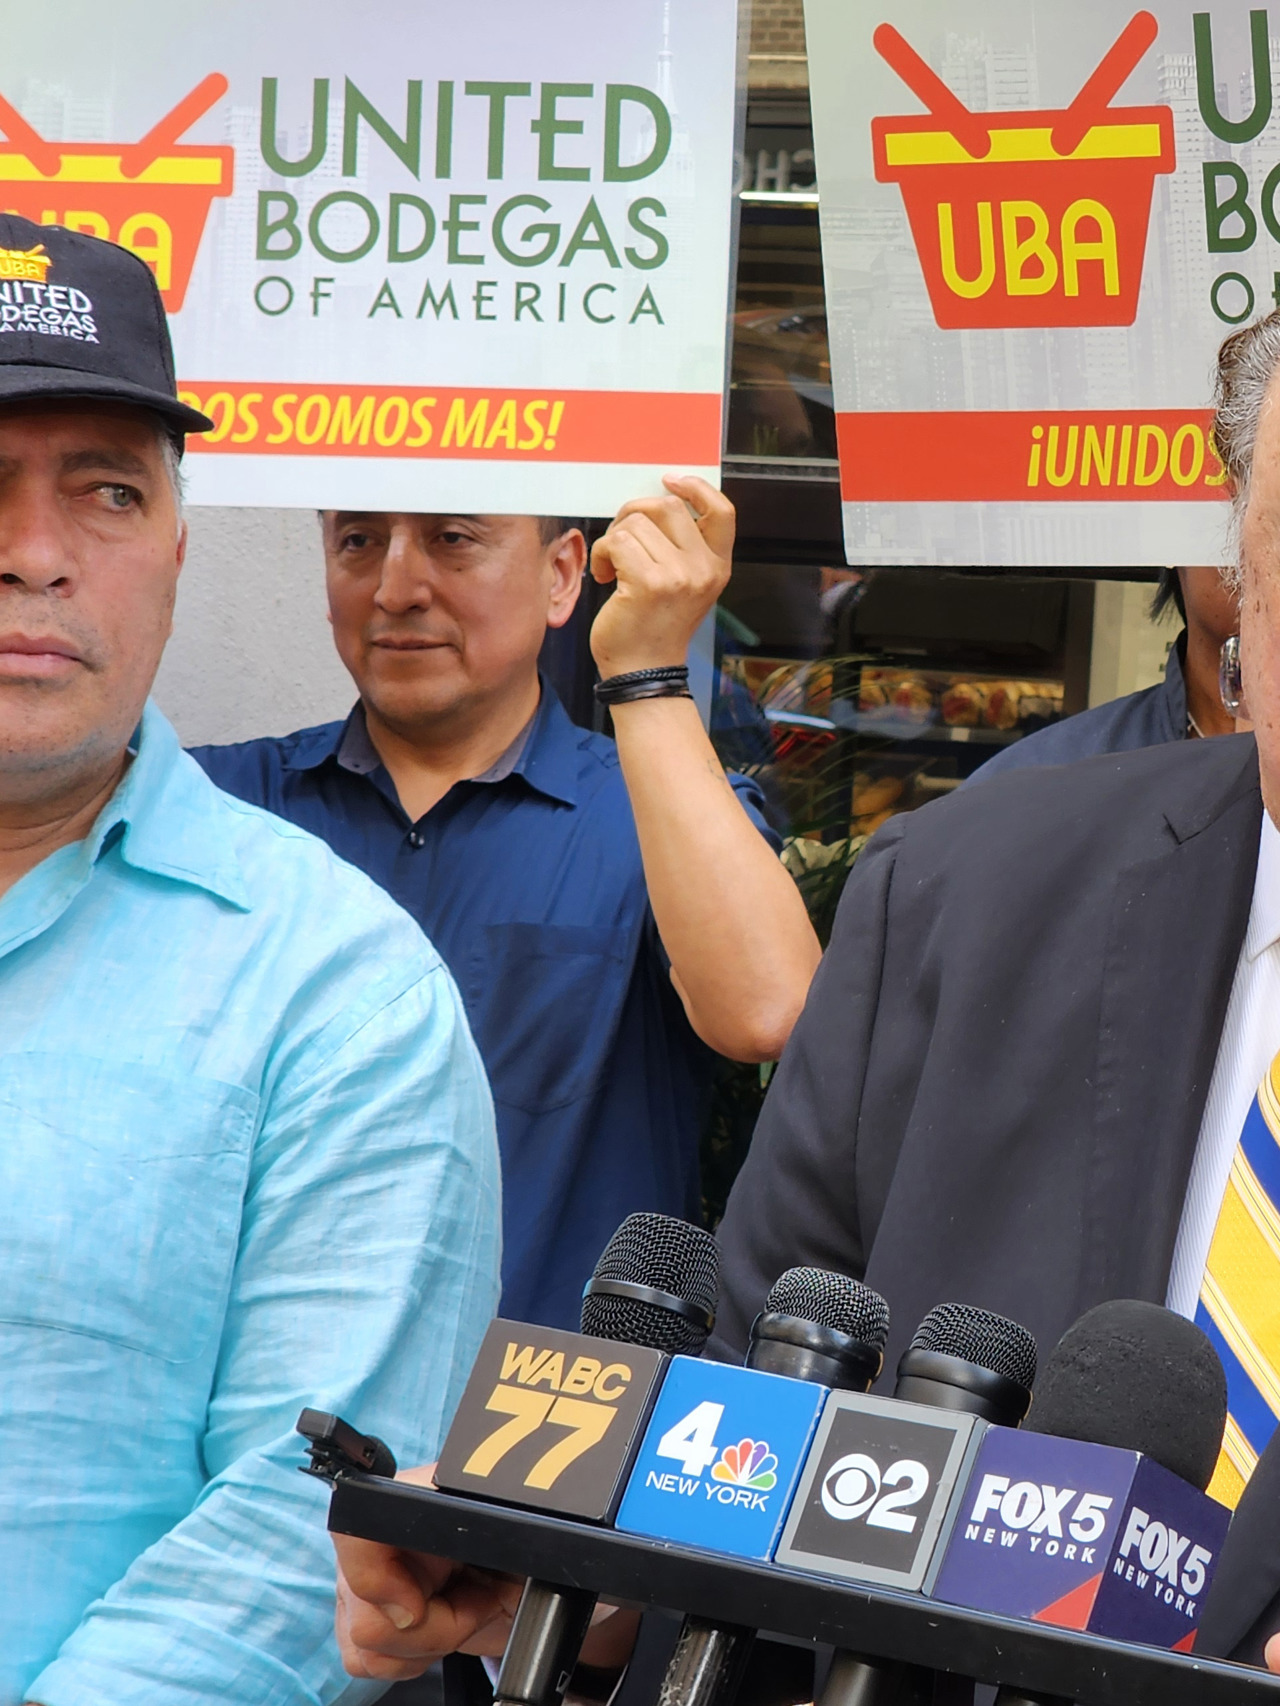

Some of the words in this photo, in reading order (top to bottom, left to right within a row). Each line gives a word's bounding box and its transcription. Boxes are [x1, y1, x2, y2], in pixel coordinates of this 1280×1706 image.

[260, 75, 672, 182] UNITED
[256, 190, 669, 270] BODEGAS
[938, 198, 1120, 298] UBA
[0, 305, 98, 334] DEGAS
[255, 276, 335, 316] OF
[368, 278, 665, 325] AMERICA
[265, 393, 437, 449] SOMOS
[439, 397, 565, 451] MAS!
[499, 1342, 631, 1401] WABC
[463, 1384, 618, 1490] 77
[656, 1401, 725, 1476] 4
[645, 1471, 700, 1496] NEW
[705, 1482, 770, 1512] YORK
[866, 1459, 930, 1533] 2
[965, 1525, 1018, 1548] NEW
[1029, 1537, 1096, 1564] YORK
[1113, 1559, 1149, 1588] NEW
[1154, 1582, 1198, 1619] YORK
